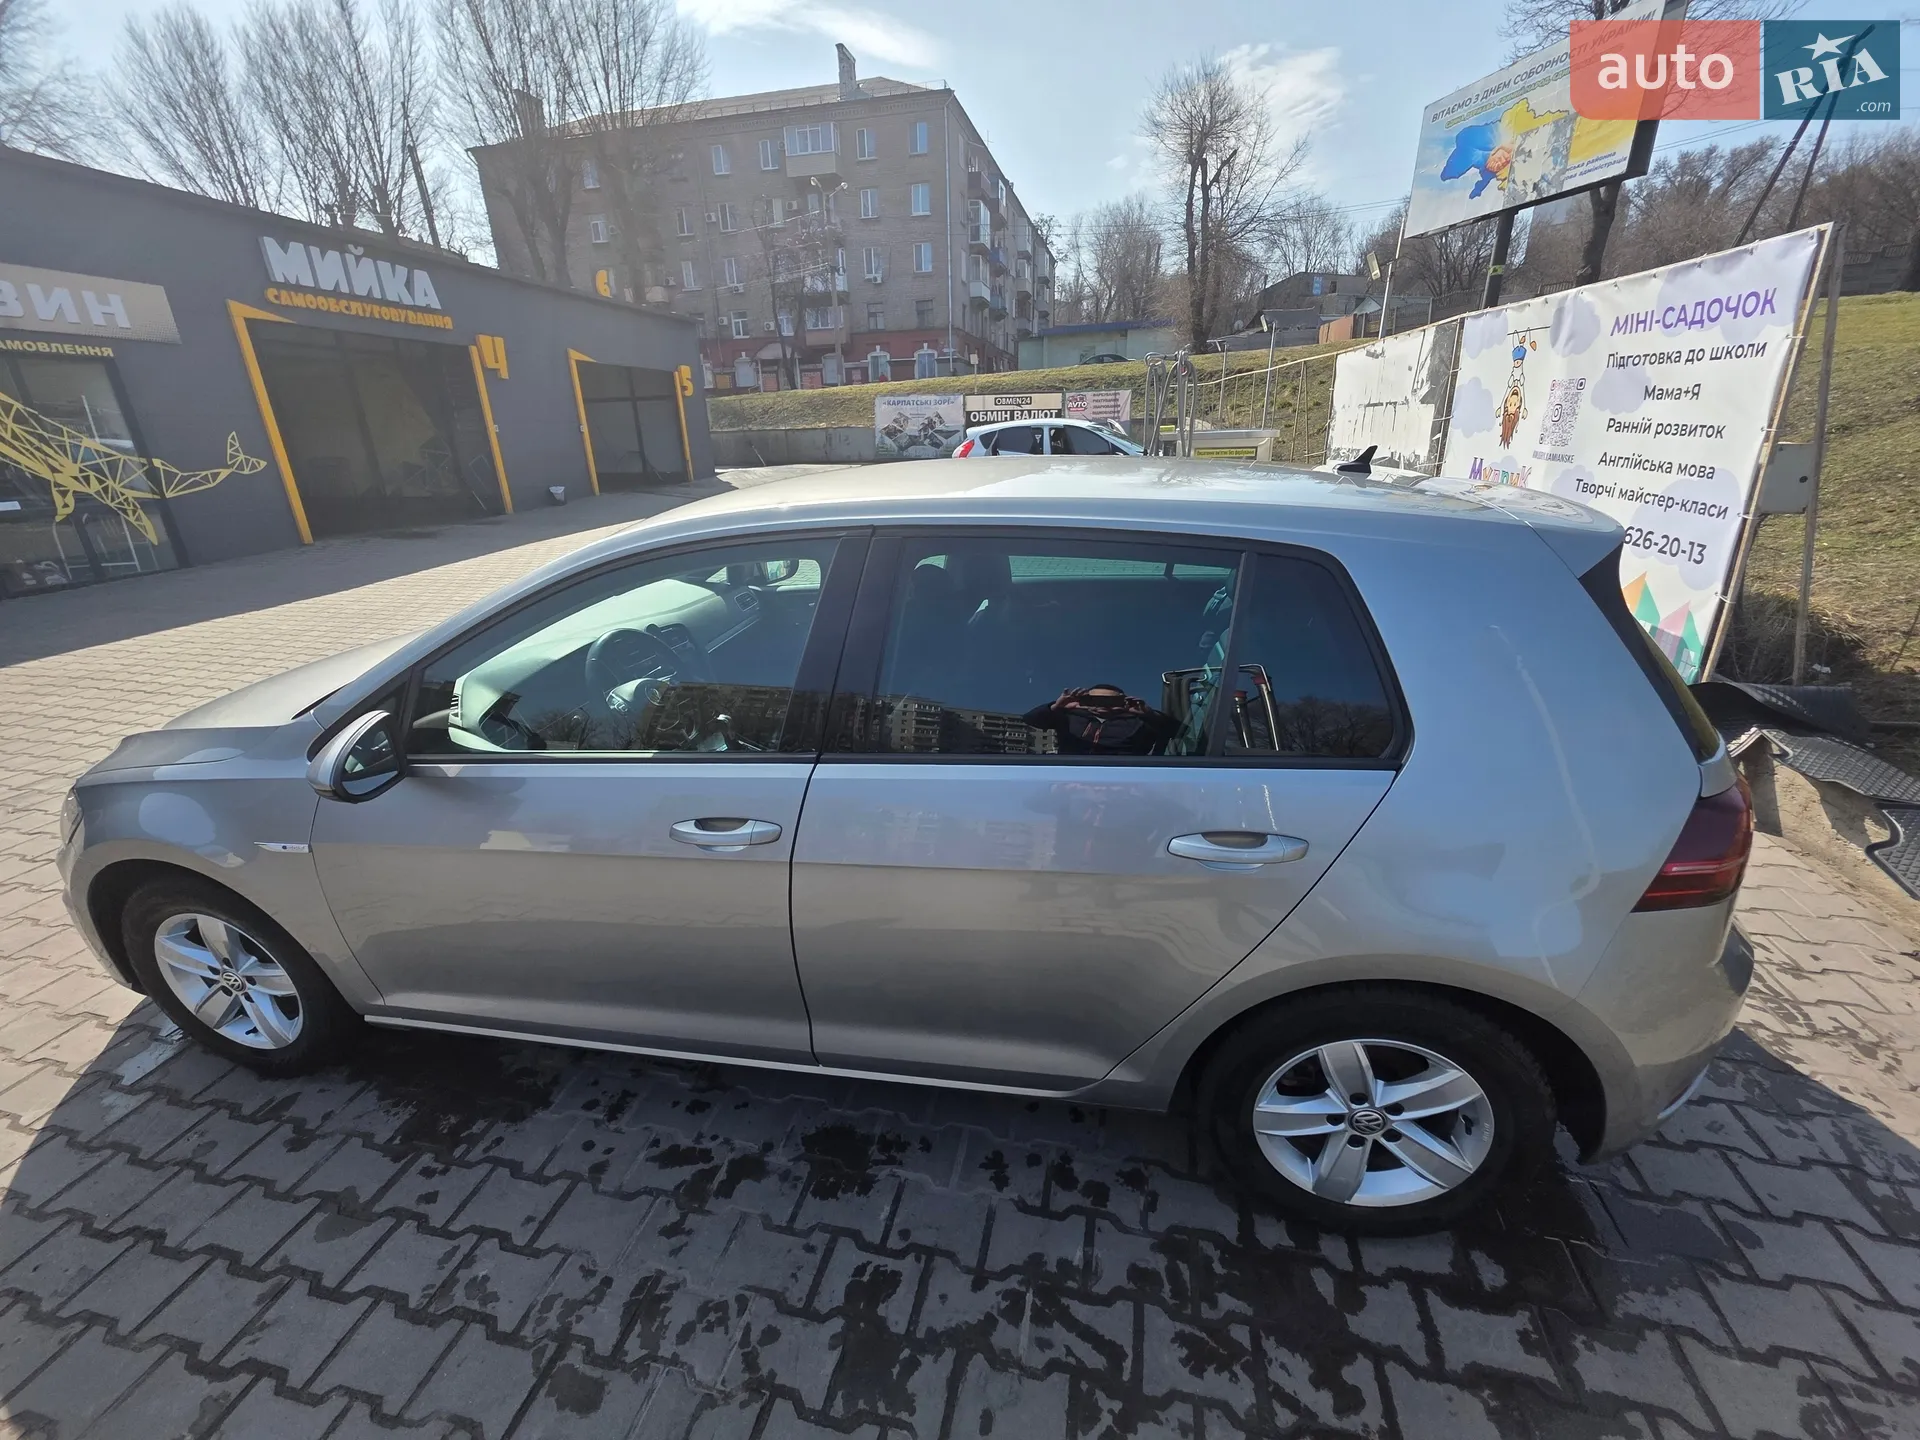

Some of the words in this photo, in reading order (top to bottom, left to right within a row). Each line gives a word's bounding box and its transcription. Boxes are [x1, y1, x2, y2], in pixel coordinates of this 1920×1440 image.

[1431, 98, 1473, 123] ВІТАЄМО
[1480, 80, 1511, 102] ДНЕМ
[260, 236, 442, 310] МИЙКА
[265, 287, 454, 331] САМООБСЛУГОВУВАННЯ
[1610, 287, 1777, 336] МІНІ-САДОЧОК
[1606, 350, 1682, 370] Підготовка
[1684, 348, 1705, 365] до
[1709, 341, 1768, 361] школи
[678, 365, 693, 396] 5
[1643, 383, 1701, 401] Мама+Я
[970, 410, 1010, 422] ОБМІН
[1014, 409, 1058, 421] ВАЛЮТ
[995, 397, 1031, 405] OBMEN24
[1606, 416, 1652, 434] Ранній
[1654, 421, 1726, 439] розвиток
[1598, 451, 1673, 475] Англійська
[1676, 463, 1716, 480] мова
[1575, 478, 1617, 498] Творчі
[1618, 486, 1729, 520] майстер-класи
[1624, 526, 1707, 565] 626-20-13
